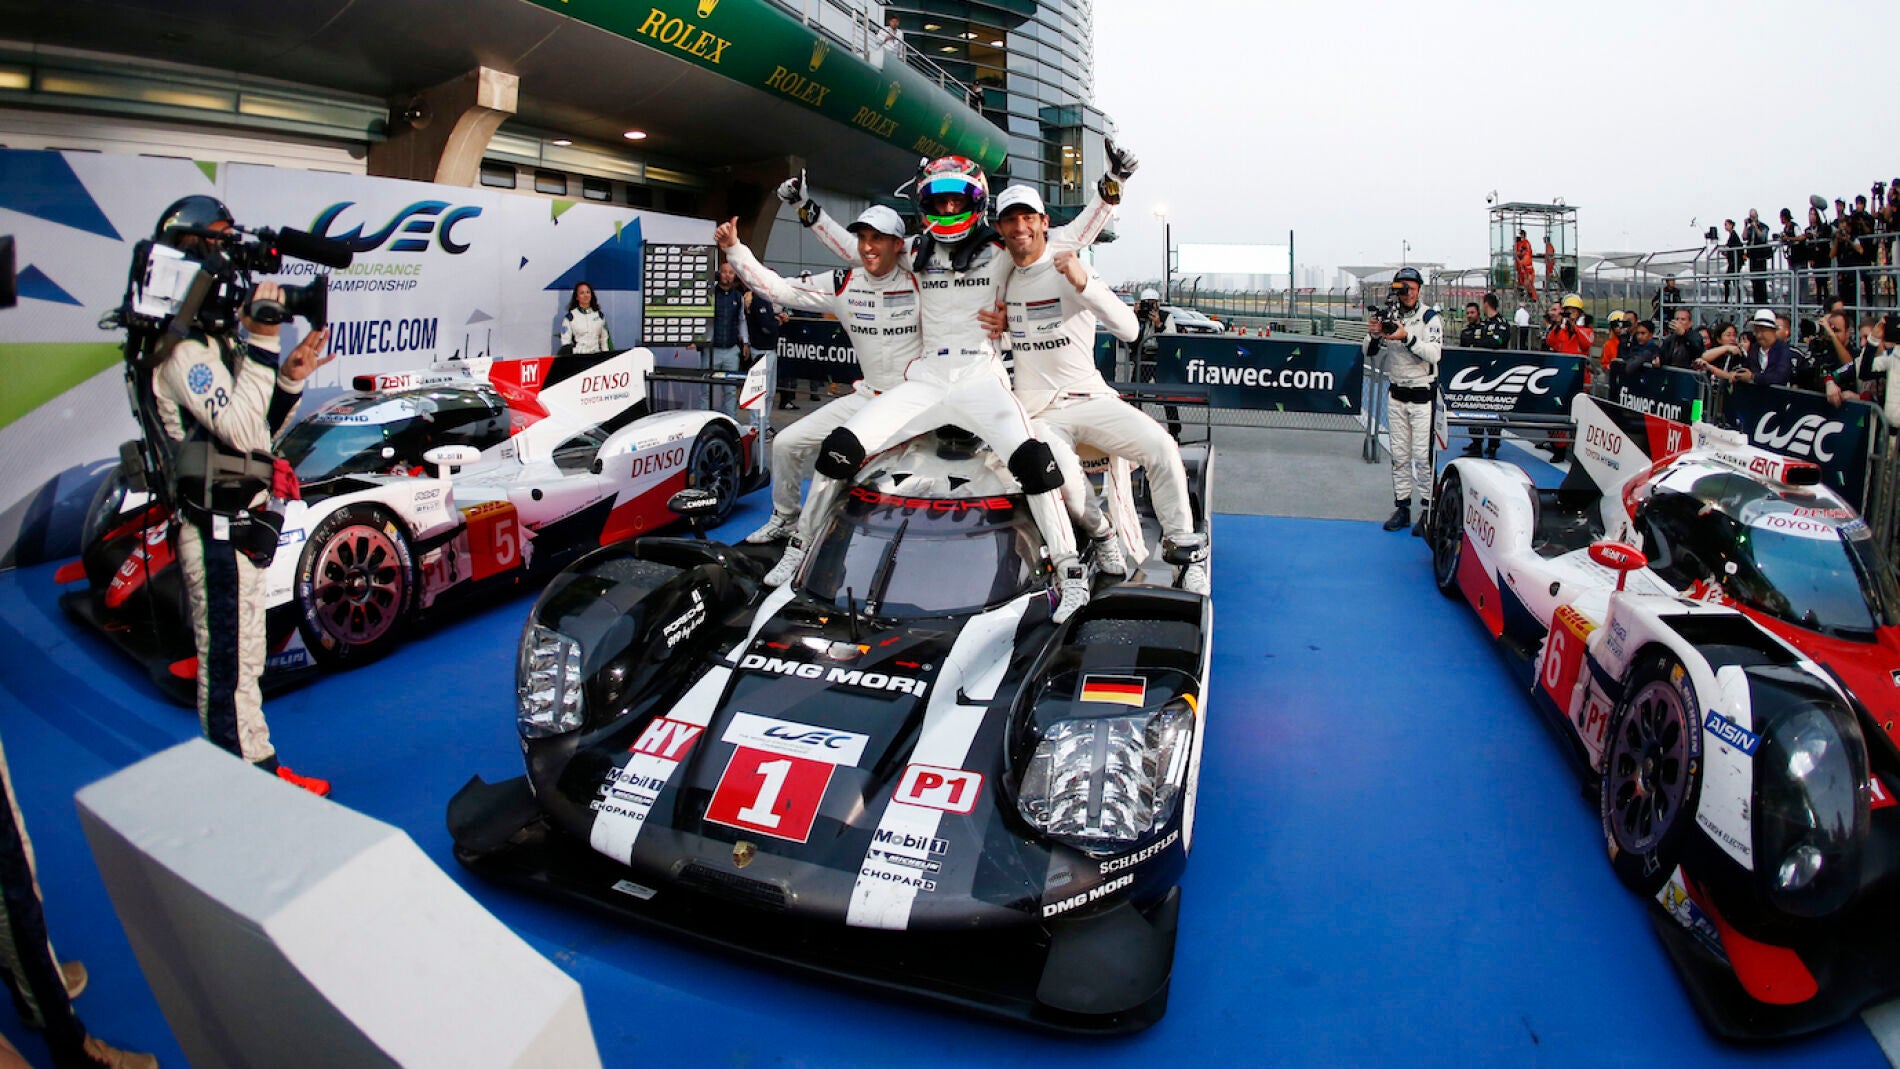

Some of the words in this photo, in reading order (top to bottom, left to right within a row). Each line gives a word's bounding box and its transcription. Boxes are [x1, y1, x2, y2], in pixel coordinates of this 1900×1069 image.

[637, 8, 731, 63] ROLEX
[765, 66, 830, 107] ROLEX
[852, 106, 898, 138] ROLEX
[309, 200, 482, 254] WEC
[279, 263, 331, 276] WORLD
[334, 263, 421, 275] ENDURANCE
[954, 278, 990, 287] MORI
[327, 279, 417, 292] HAMPIONSHIP
[327, 317, 438, 356] IAWEC.COM
[851, 325, 878, 335] DMG
[882, 325, 917, 335] MORI
[1012, 343, 1031, 351] MG
[1033, 337, 1070, 350] MORI
[777, 337, 857, 364] fiawec.com
[381, 375, 411, 389] ZENT
[521, 363, 538, 383] HY
[580, 371, 630, 394] DENSO
[1186, 359, 1334, 390] fiawec.com
[1449, 365, 1559, 395] WEC
[205, 387, 229, 419] 28
[1451, 402, 1515, 411] CHAMPIONSHIP
[1464, 395, 1518, 404] ENDURANCE
[1586, 424, 1622, 455] DENSO
[1666, 429, 1682, 453] HY
[1753, 412, 1844, 463] WEC
[631, 447, 685, 479] DENSO
[1749, 455, 1779, 479] ZENT
[851, 487, 1013, 512] PORSCHE
[1465, 503, 1496, 548] DENSO
[1767, 514, 1832, 534] TOYOTA
[495, 518, 515, 566] 5
[425, 561, 446, 587] P1
[1546, 629, 1565, 689] 6
[739, 654, 823, 679] DMG
[825, 667, 928, 698] MORI
[1586, 703, 1608, 742] P1
[1684, 685, 1699, 753] MICHELIN
[1706, 714, 1755, 751] AISIN
[633, 718, 702, 758] HY
[763, 726, 852, 749] WEC
[607, 767, 650, 787] Mobil
[909, 771, 967, 805] P1
[737, 758, 792, 829] 1
[591, 801, 645, 821] CHOPARD
[874, 828, 928, 850] Mobil
[929, 838, 947, 854] 1
[1099, 829, 1179, 875] SCHAEFFLER
[861, 867, 934, 890] CHOPARD
[1042, 893, 1087, 919] DMG
[1089, 873, 1134, 902] MORI
